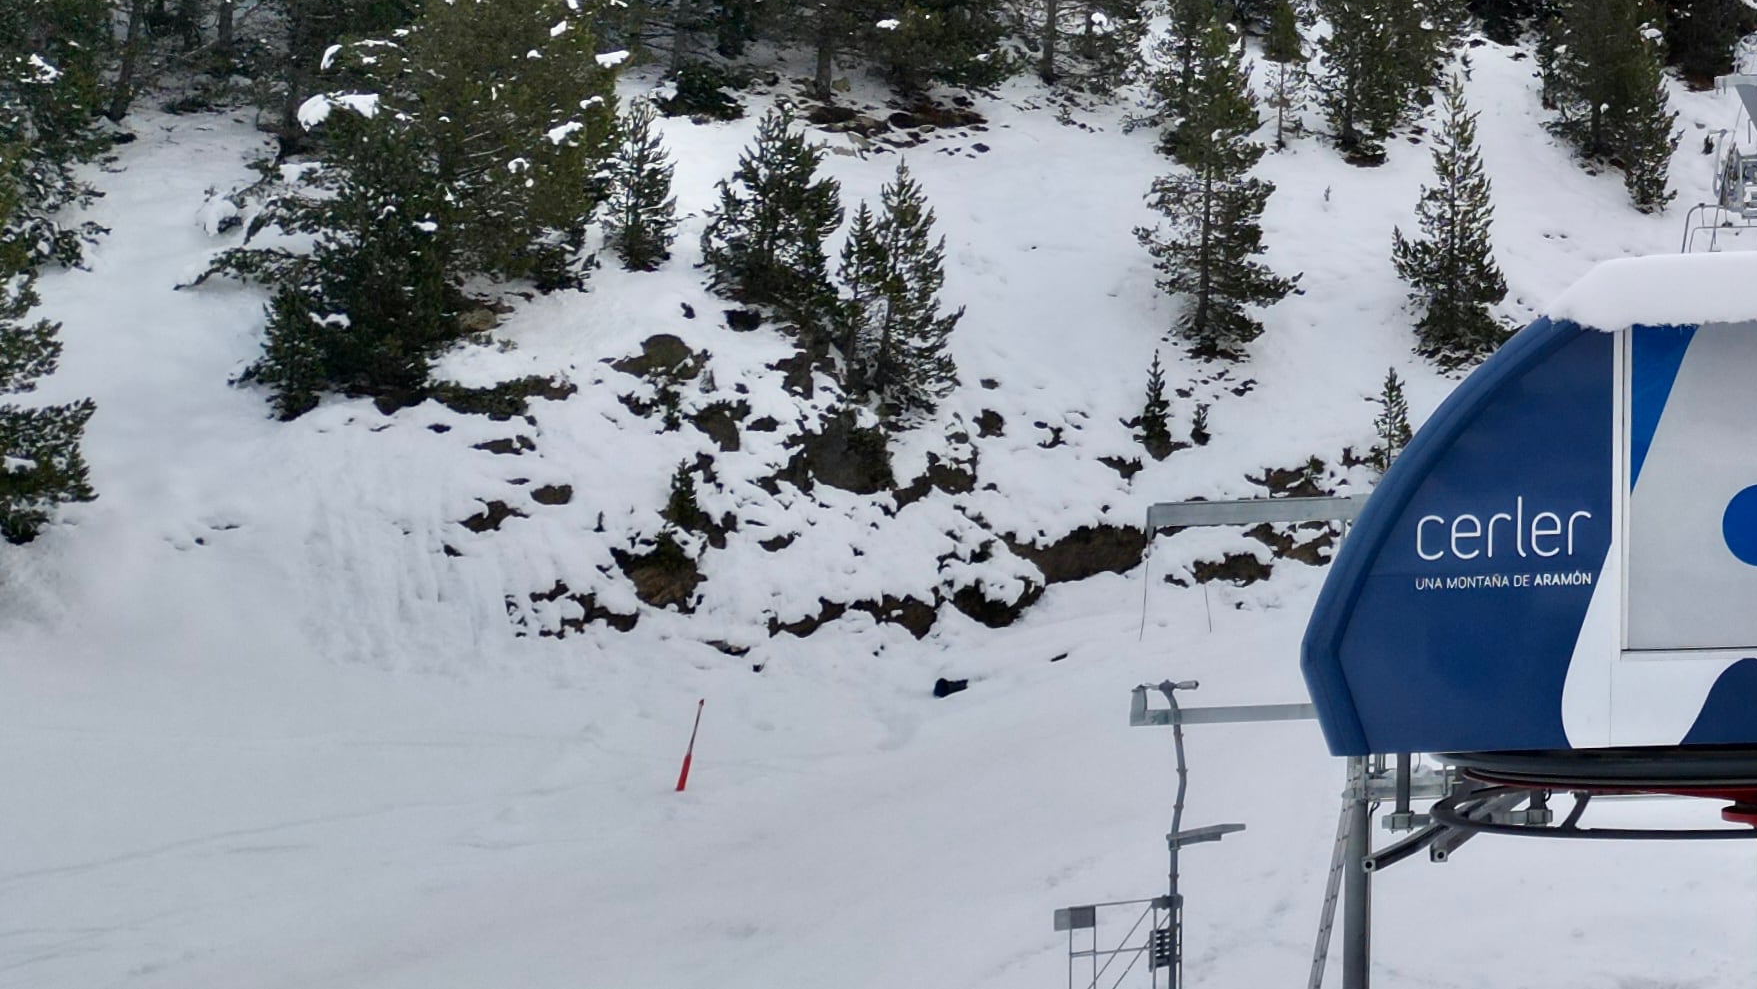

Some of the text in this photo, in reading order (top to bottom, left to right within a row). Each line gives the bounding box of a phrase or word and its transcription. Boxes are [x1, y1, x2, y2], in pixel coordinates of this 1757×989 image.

[1416, 495, 1592, 561] cerler
[1415, 570, 1592, 590] UNA MONTAÑA DE ARAMÓN
